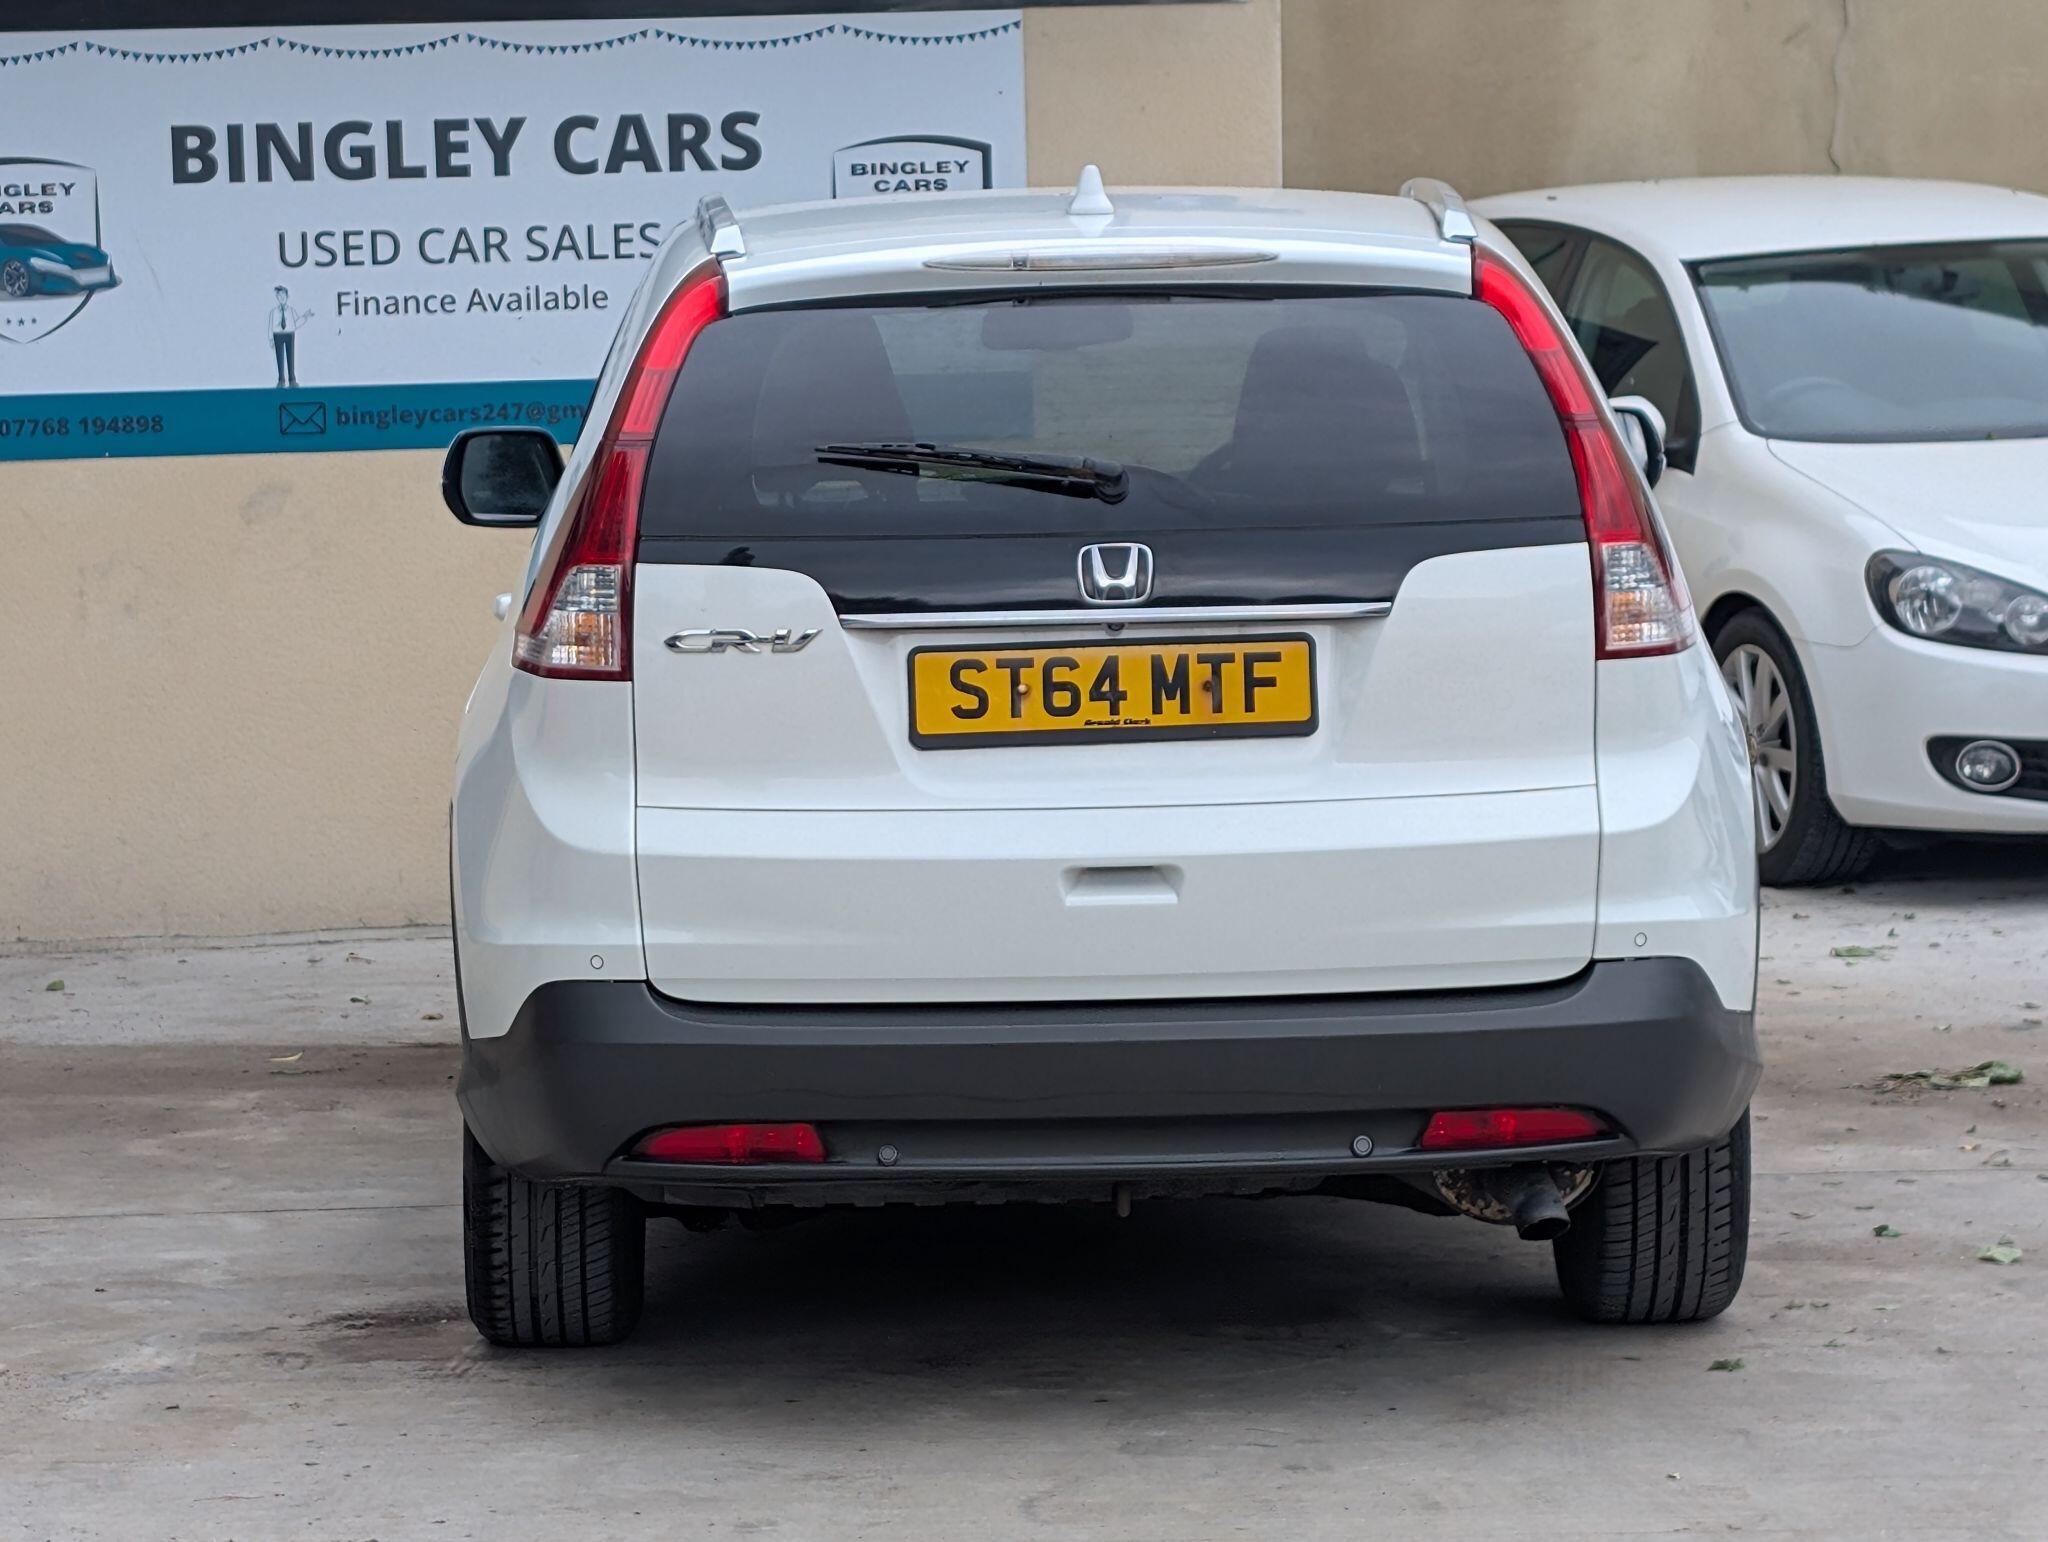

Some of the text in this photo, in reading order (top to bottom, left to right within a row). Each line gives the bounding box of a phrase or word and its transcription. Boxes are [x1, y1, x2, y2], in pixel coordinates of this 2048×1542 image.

[171, 111, 762, 184] BINGLEY CARS
[851, 159, 970, 176] BINGLEY
[0, 182, 76, 197] GLEY
[874, 178, 948, 192] CARS
[279, 222, 661, 267] USED CAR SALES
[337, 284, 609, 316] Finance Available
[0, 414, 164, 437] 07768 194898
[949, 651, 1281, 719] ST64 MTF
